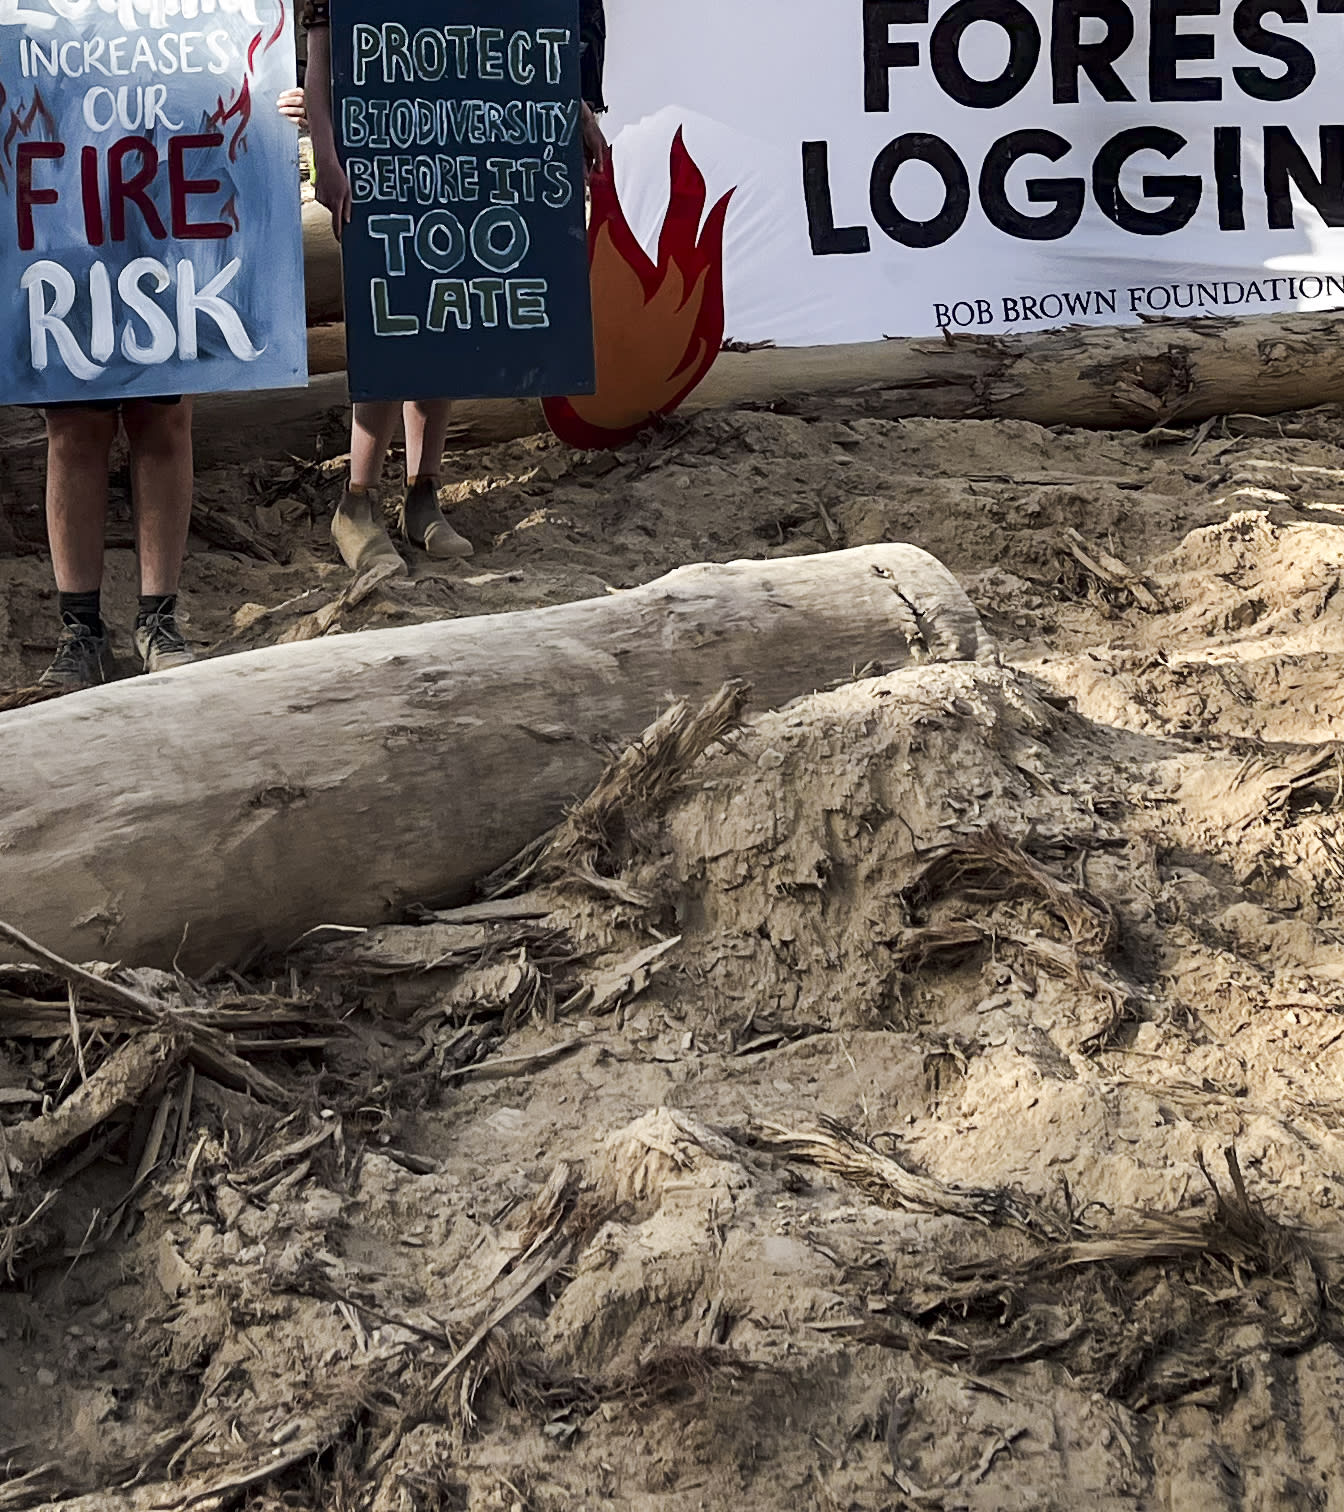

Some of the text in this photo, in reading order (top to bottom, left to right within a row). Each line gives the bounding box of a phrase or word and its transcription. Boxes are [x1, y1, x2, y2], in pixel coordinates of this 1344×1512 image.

[19, 30, 230, 79] INCREASES
[353, 23, 570, 86] PROTECT
[81, 83, 183, 133] OUR
[342, 97, 582, 148] BIODIVERSITY
[15, 133, 233, 251] FIRE
[346, 145, 572, 208] BEFORE IT'S
[368, 205, 529, 276] TOO
[20, 256, 268, 381] RISK
[370, 278, 549, 336] LATE
[933, 299, 993, 328] BOB
[1003, 289, 1117, 322] BROWN
